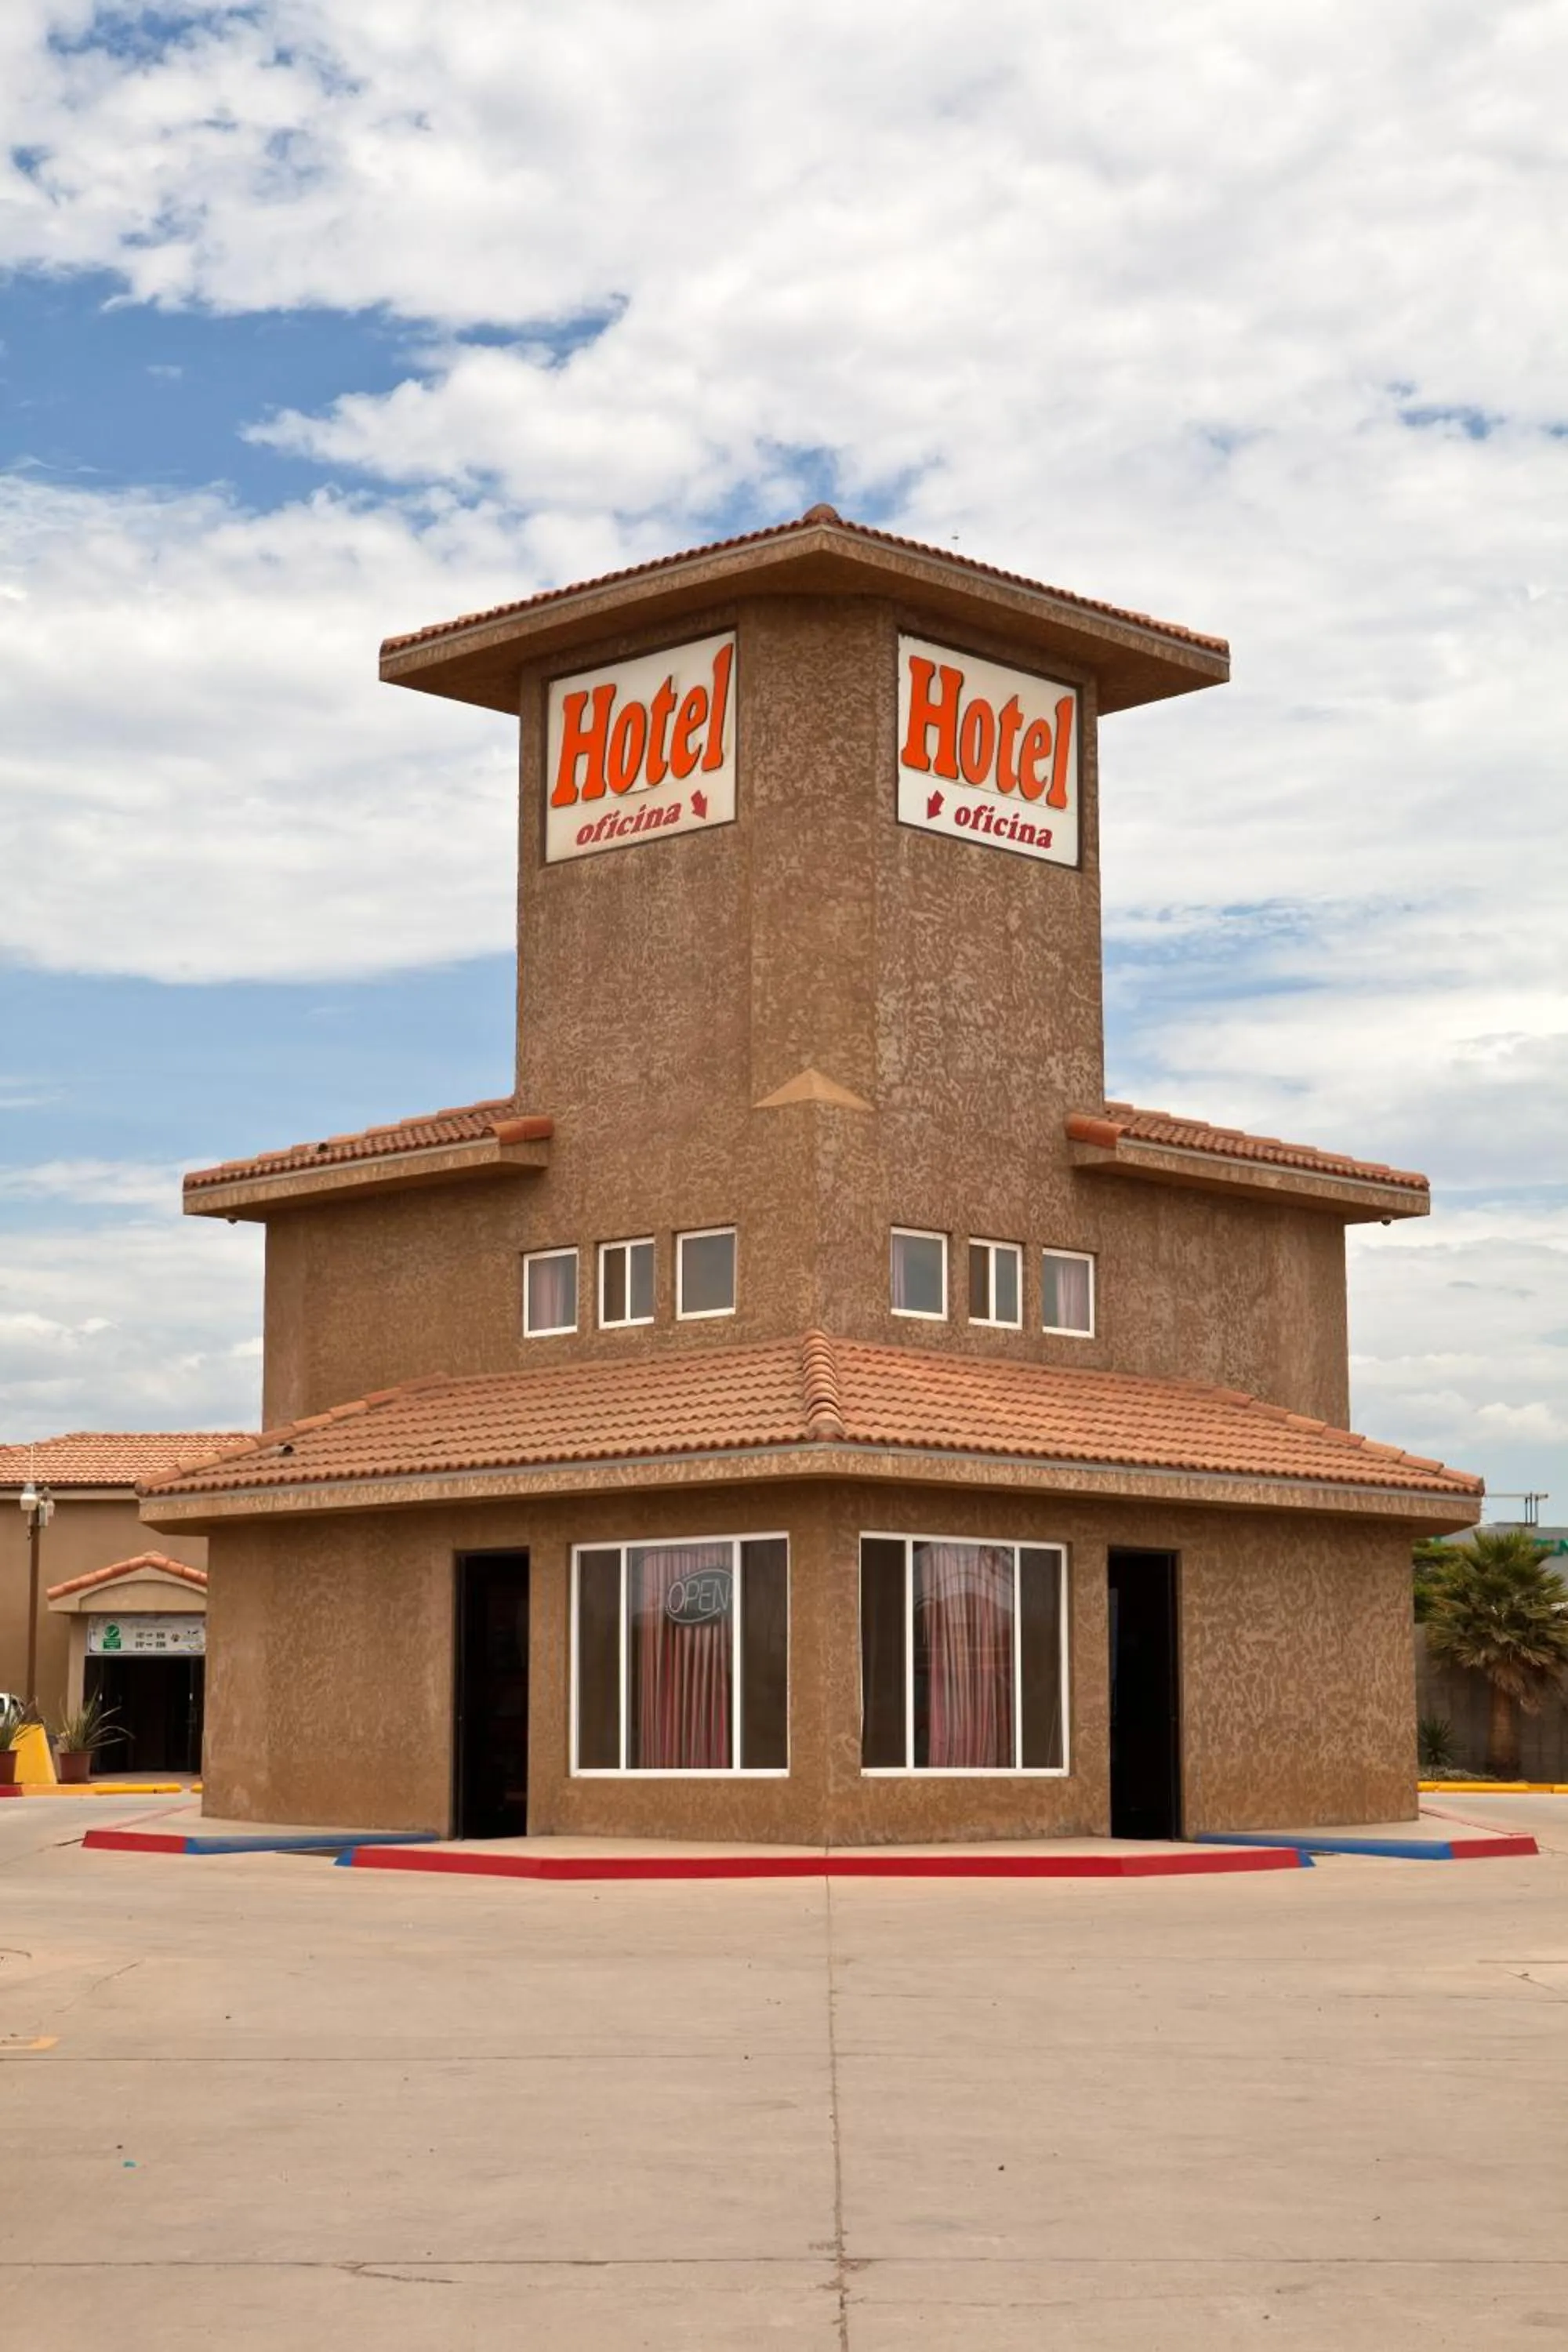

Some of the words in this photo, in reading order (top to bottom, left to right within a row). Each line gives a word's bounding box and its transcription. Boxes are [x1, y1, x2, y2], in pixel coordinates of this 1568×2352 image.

[551, 642, 734, 808] Hotel
[901, 655, 1073, 809] Hotel
[576, 803, 682, 846] oficina
[954, 804, 1052, 849] oficina
[668, 1578, 731, 1613] OPEN
